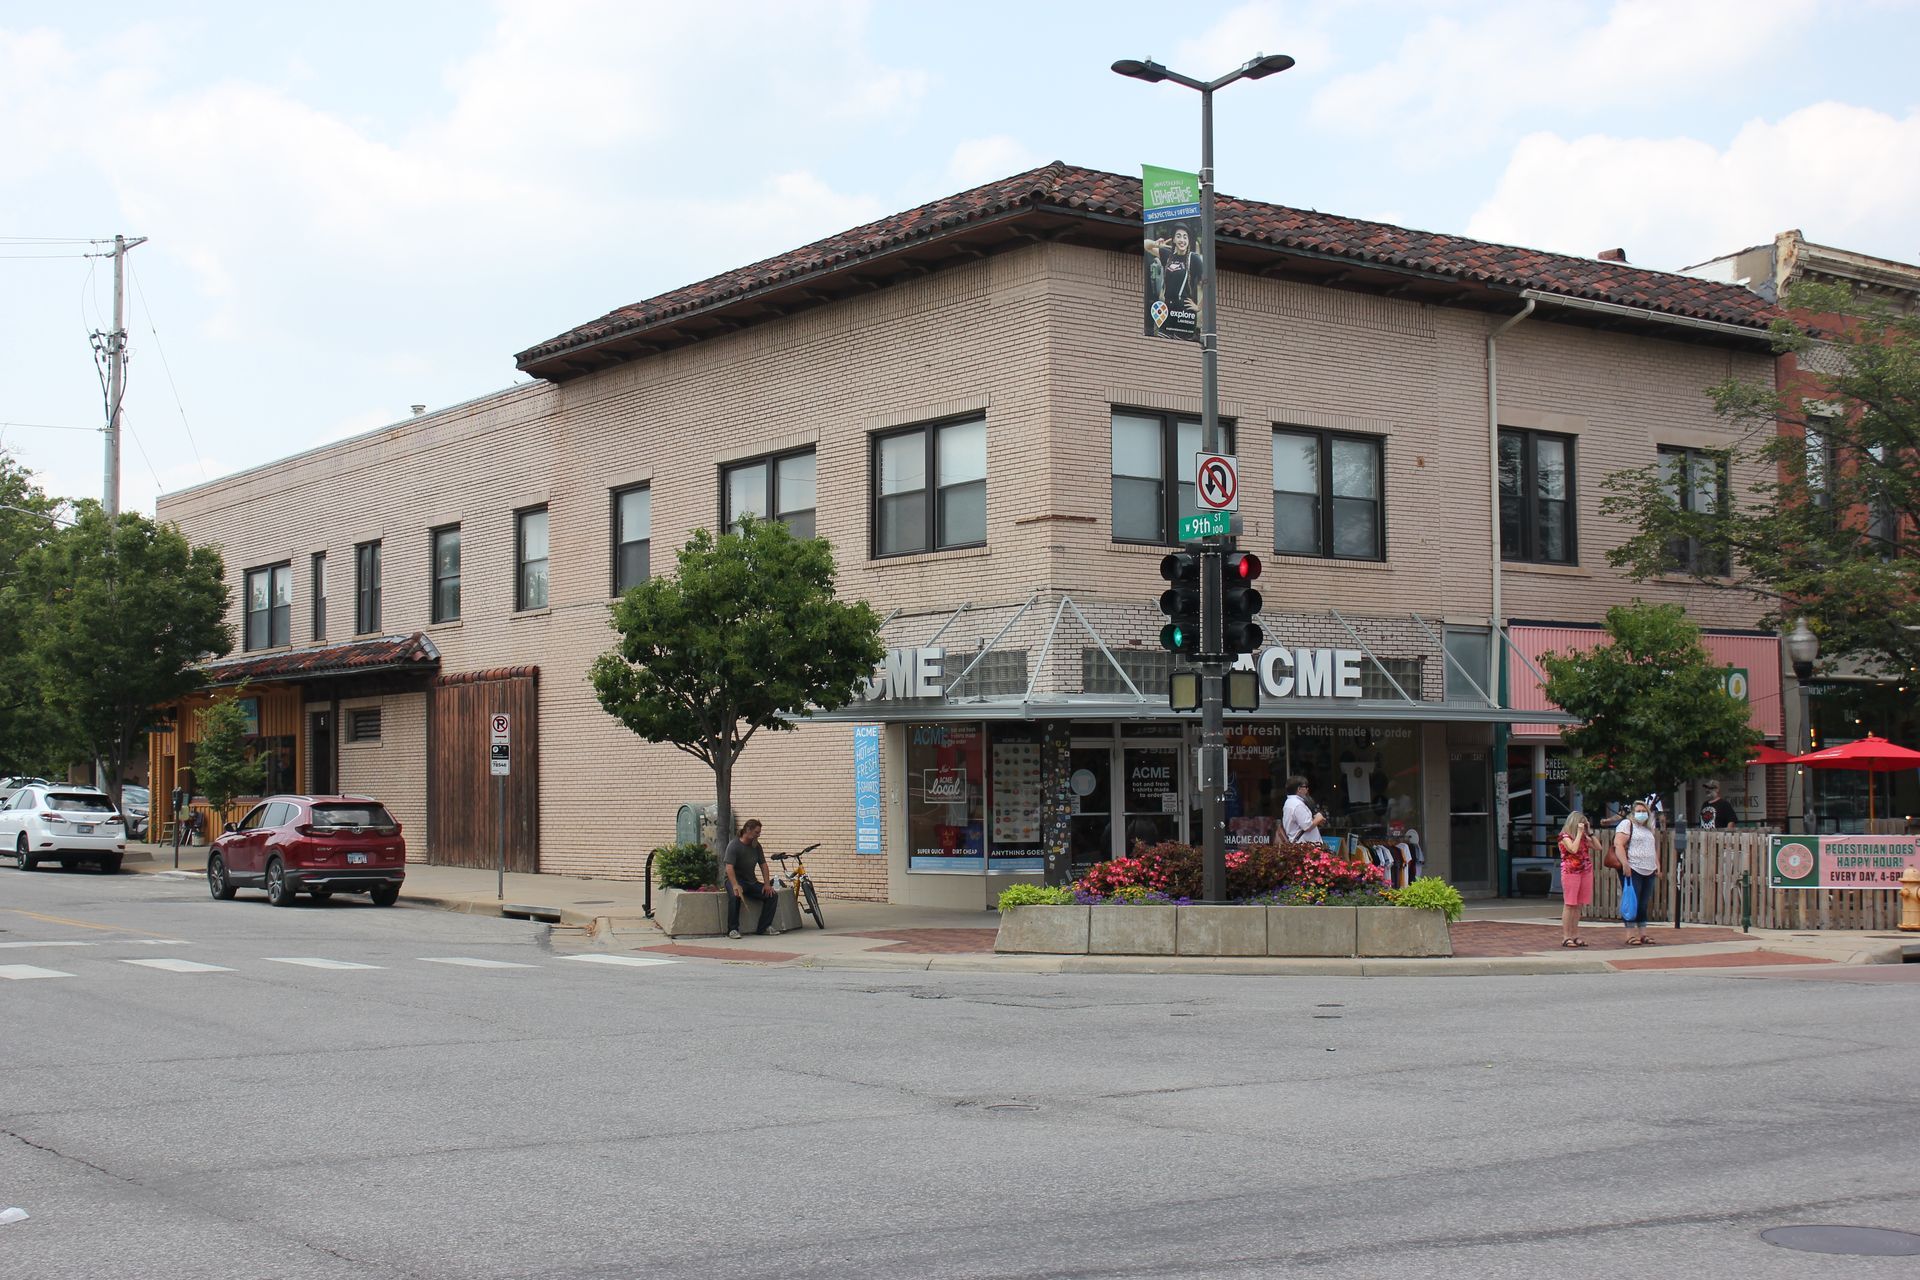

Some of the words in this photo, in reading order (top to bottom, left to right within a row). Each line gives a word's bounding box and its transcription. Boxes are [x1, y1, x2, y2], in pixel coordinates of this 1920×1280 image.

[1150, 186, 1193, 206] LAWRENCE
[1169, 309, 1196, 319] explore
[1185, 524, 1191, 533] W
[1192, 517, 1211, 535] 9th
[1214, 512, 1222, 522] ST
[856, 727, 877, 738] ACME
[1248, 724, 1281, 736] fresh
[1297, 725, 1334, 736] t-shirts
[1338, 726, 1367, 737] made
[1370, 726, 1380, 737] to
[1384, 727, 1412, 738] order
[857, 744, 867, 762] HOT
[857, 751, 878, 780] FRESH
[1132, 766, 1170, 779] ACME
[928, 777, 960, 796] local
[1026, 848, 1045, 856] GOES
[1825, 843, 1887, 855] PEDESTRIAN
[1888, 843, 1916, 856] DOES
[1837, 856, 1871, 868] HAPPY
[1872, 857, 1904, 868] HOUR!
[1830, 871, 1857, 881] EVERY
[1859, 871, 1878, 883] DAY,
